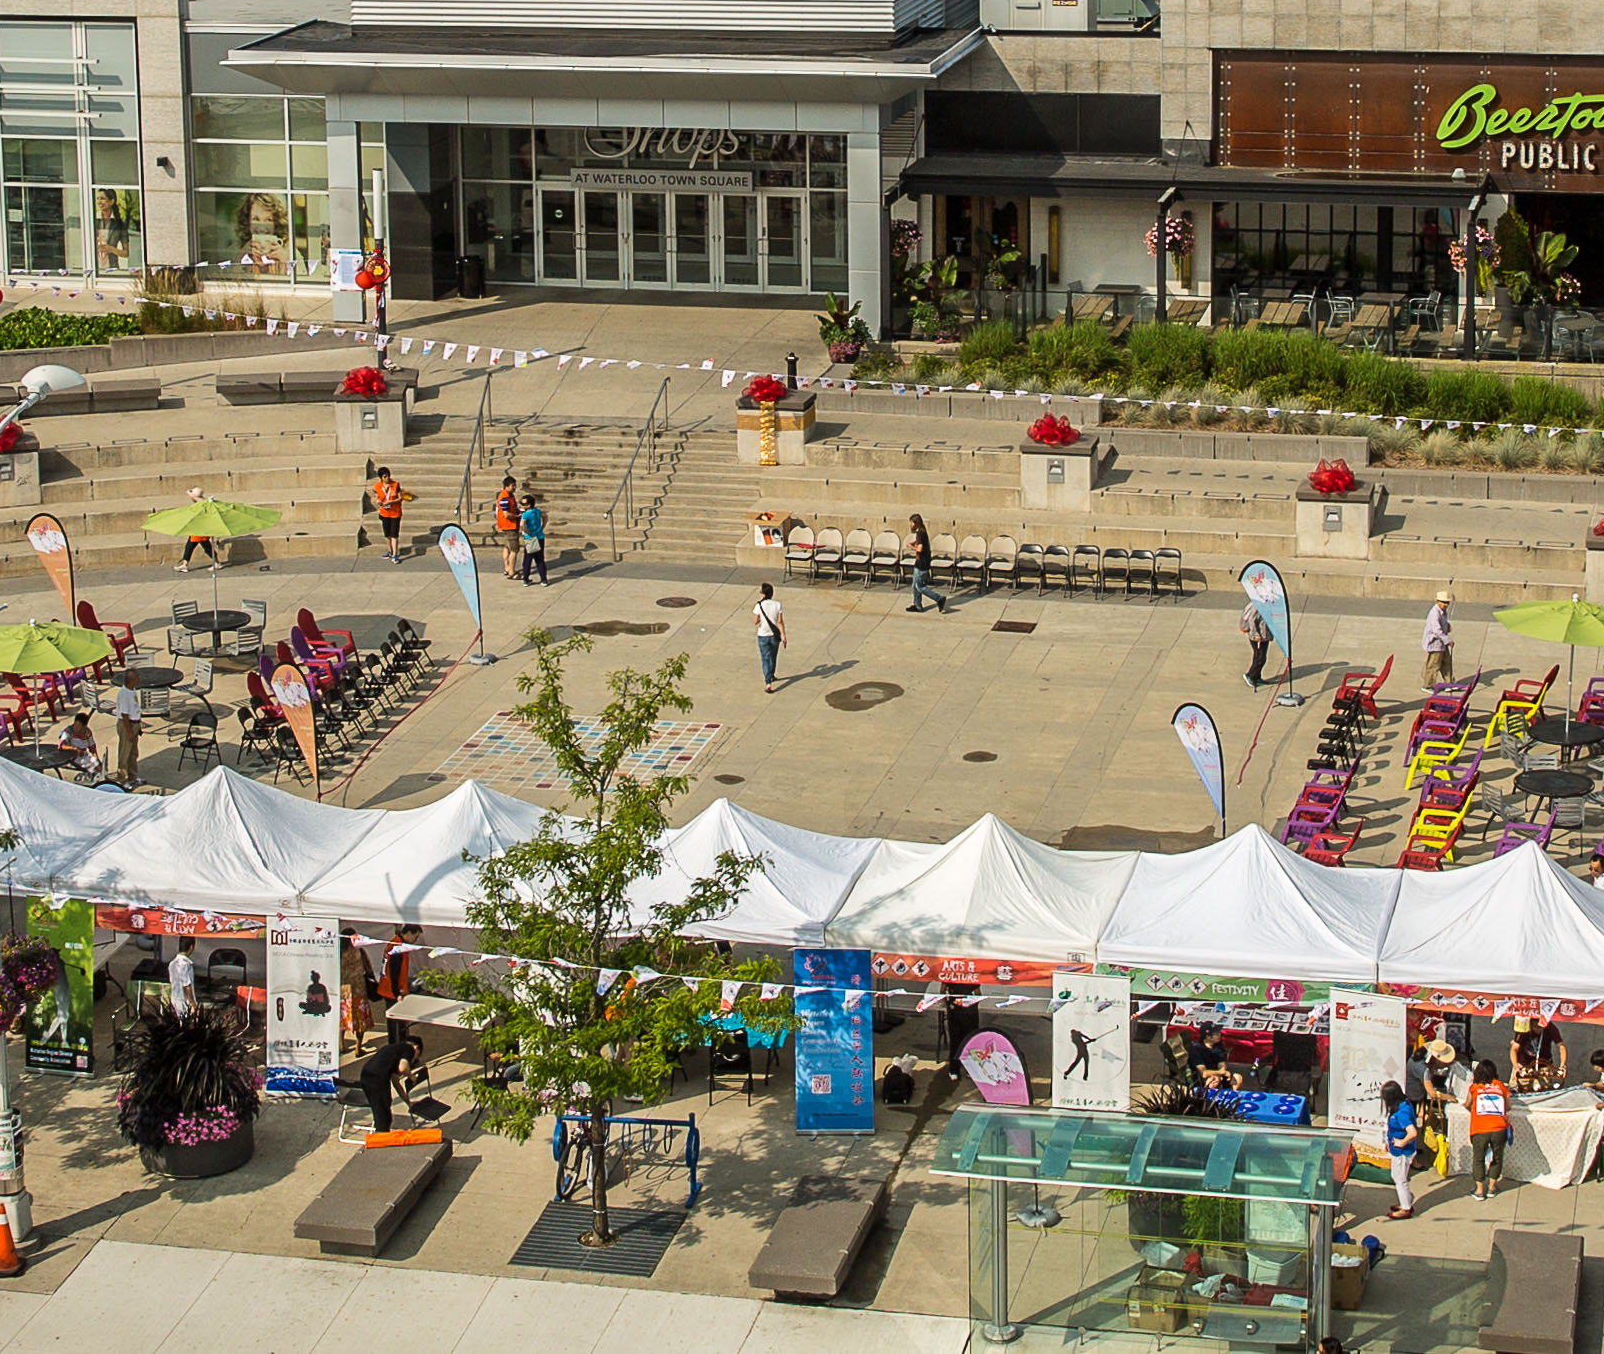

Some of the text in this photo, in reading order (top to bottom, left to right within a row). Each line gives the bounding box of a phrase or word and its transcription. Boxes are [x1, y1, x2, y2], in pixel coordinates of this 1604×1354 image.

[1501, 141, 1596, 171] PUBLIC
[574, 173, 749, 188] AT WATERLOO TOWN SQUARE
[941, 959, 977, 972] ARTS &
[938, 971, 979, 983] CULTURE
[1211, 982, 1260, 997] FESTIVITY
[1505, 996, 1537, 1008] ARTS &
[1503, 1006, 1540, 1017] ULTURE
